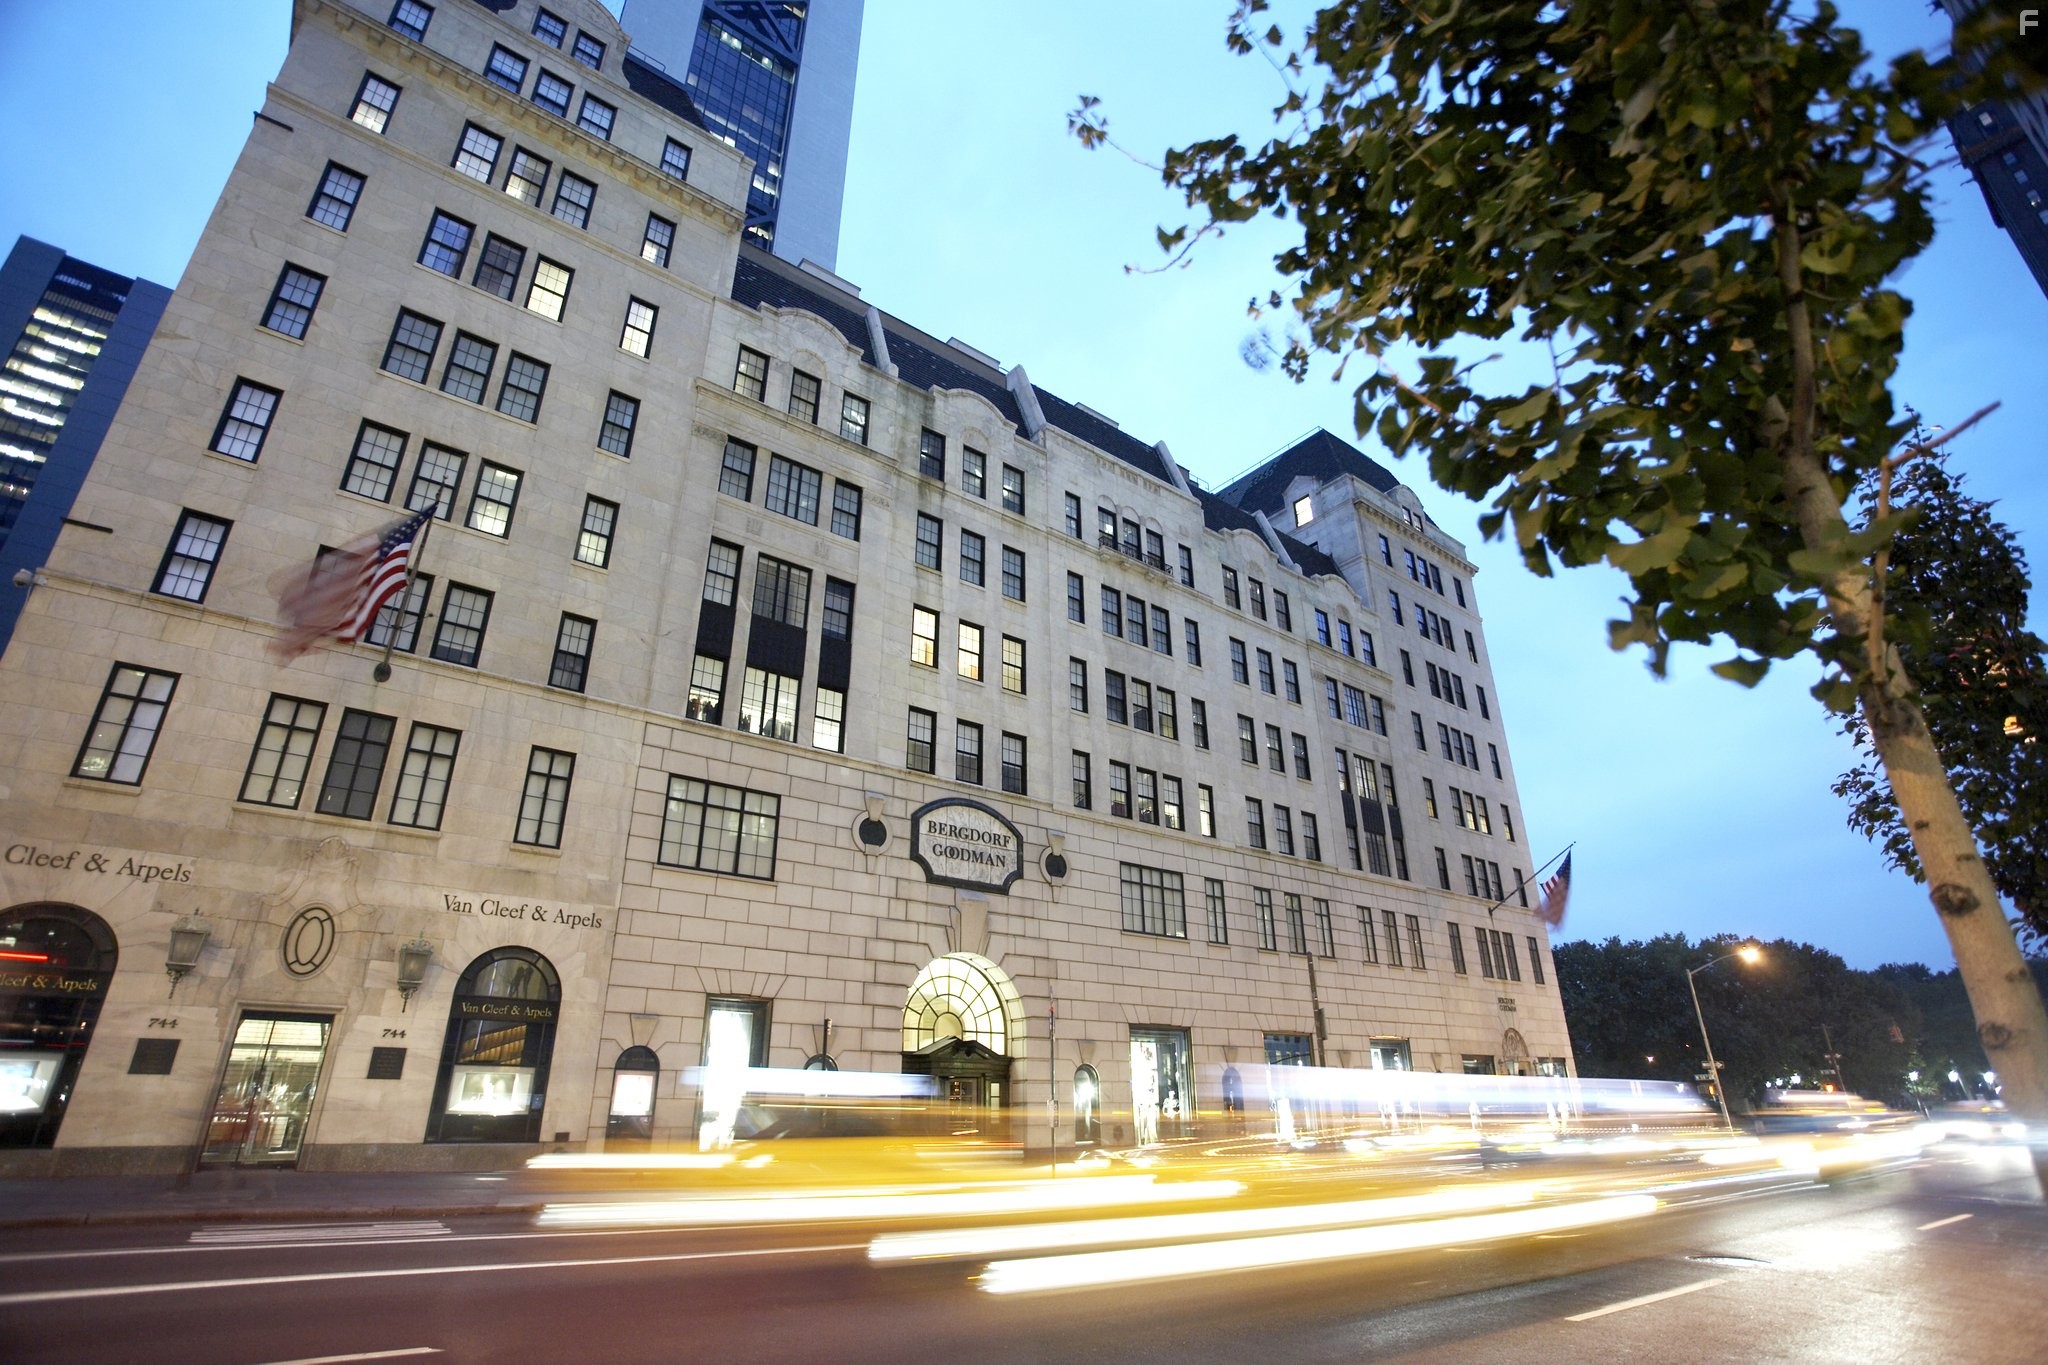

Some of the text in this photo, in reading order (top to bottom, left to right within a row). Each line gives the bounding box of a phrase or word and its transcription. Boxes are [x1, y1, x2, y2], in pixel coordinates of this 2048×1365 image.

[928, 820, 1011, 848] BERGDORF
[4, 843, 192, 883] Cleef & Arpels
[932, 843, 1006, 868] GOODMAN
[443, 894, 603, 929] Van Cleef & Arpels
[0, 973, 98, 992] leef & Arpels
[462, 1002, 552, 1019] Van Cleef & Arpels
[148, 1018, 179, 1028] 744
[382, 1029, 407, 1039] 744
